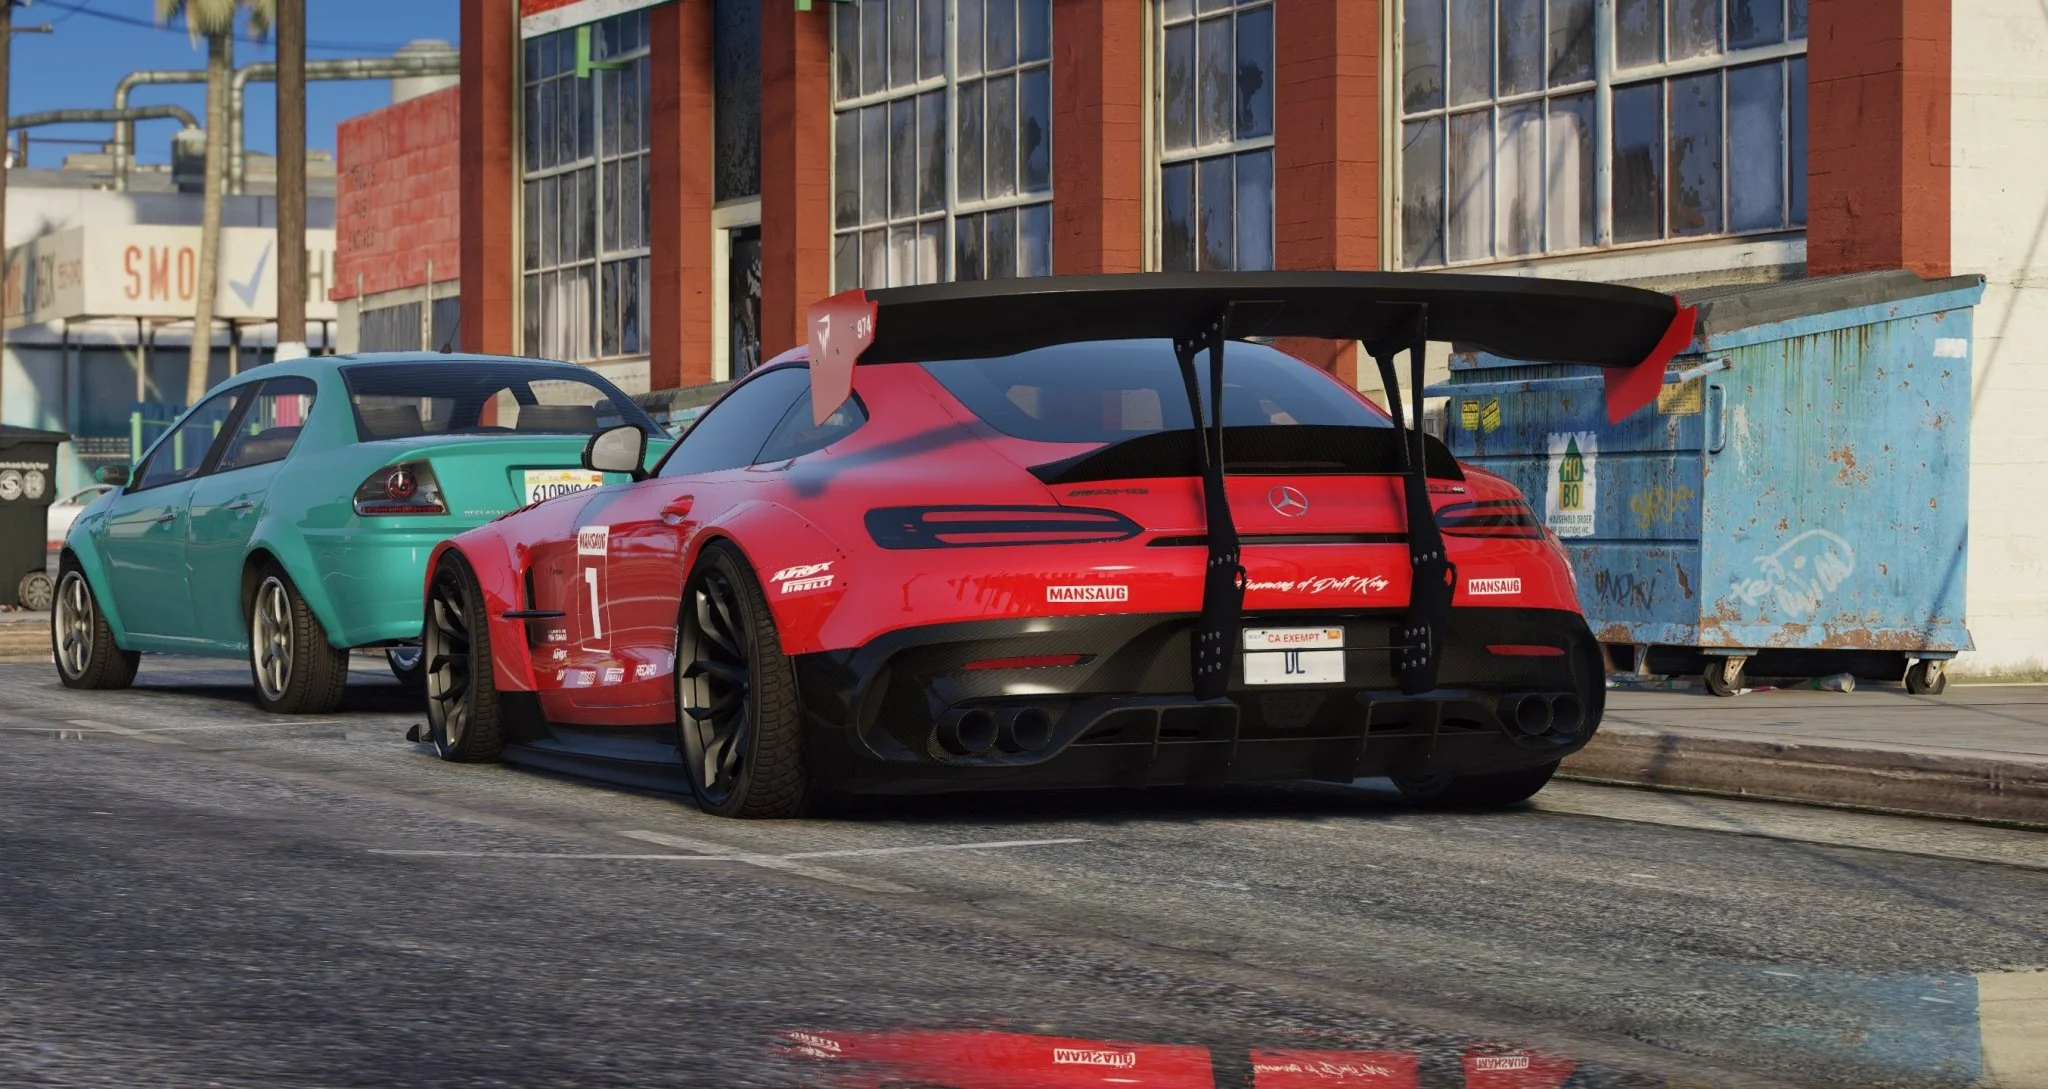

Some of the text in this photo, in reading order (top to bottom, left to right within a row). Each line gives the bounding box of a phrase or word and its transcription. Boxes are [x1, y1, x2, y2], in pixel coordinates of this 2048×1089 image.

[124, 245, 196, 301] SMO
[857, 314, 872, 339] 974
[781, 574, 835, 594] PIRELLI
[1049, 587, 1126, 601] MANSAUG
[1470, 579, 1520, 593] MANSAUG
[585, 567, 602, 640] 1
[1268, 633, 1320, 643] CA EXEMPT
[635, 663, 657, 676] RECARO
[1285, 651, 1306, 674] DL
